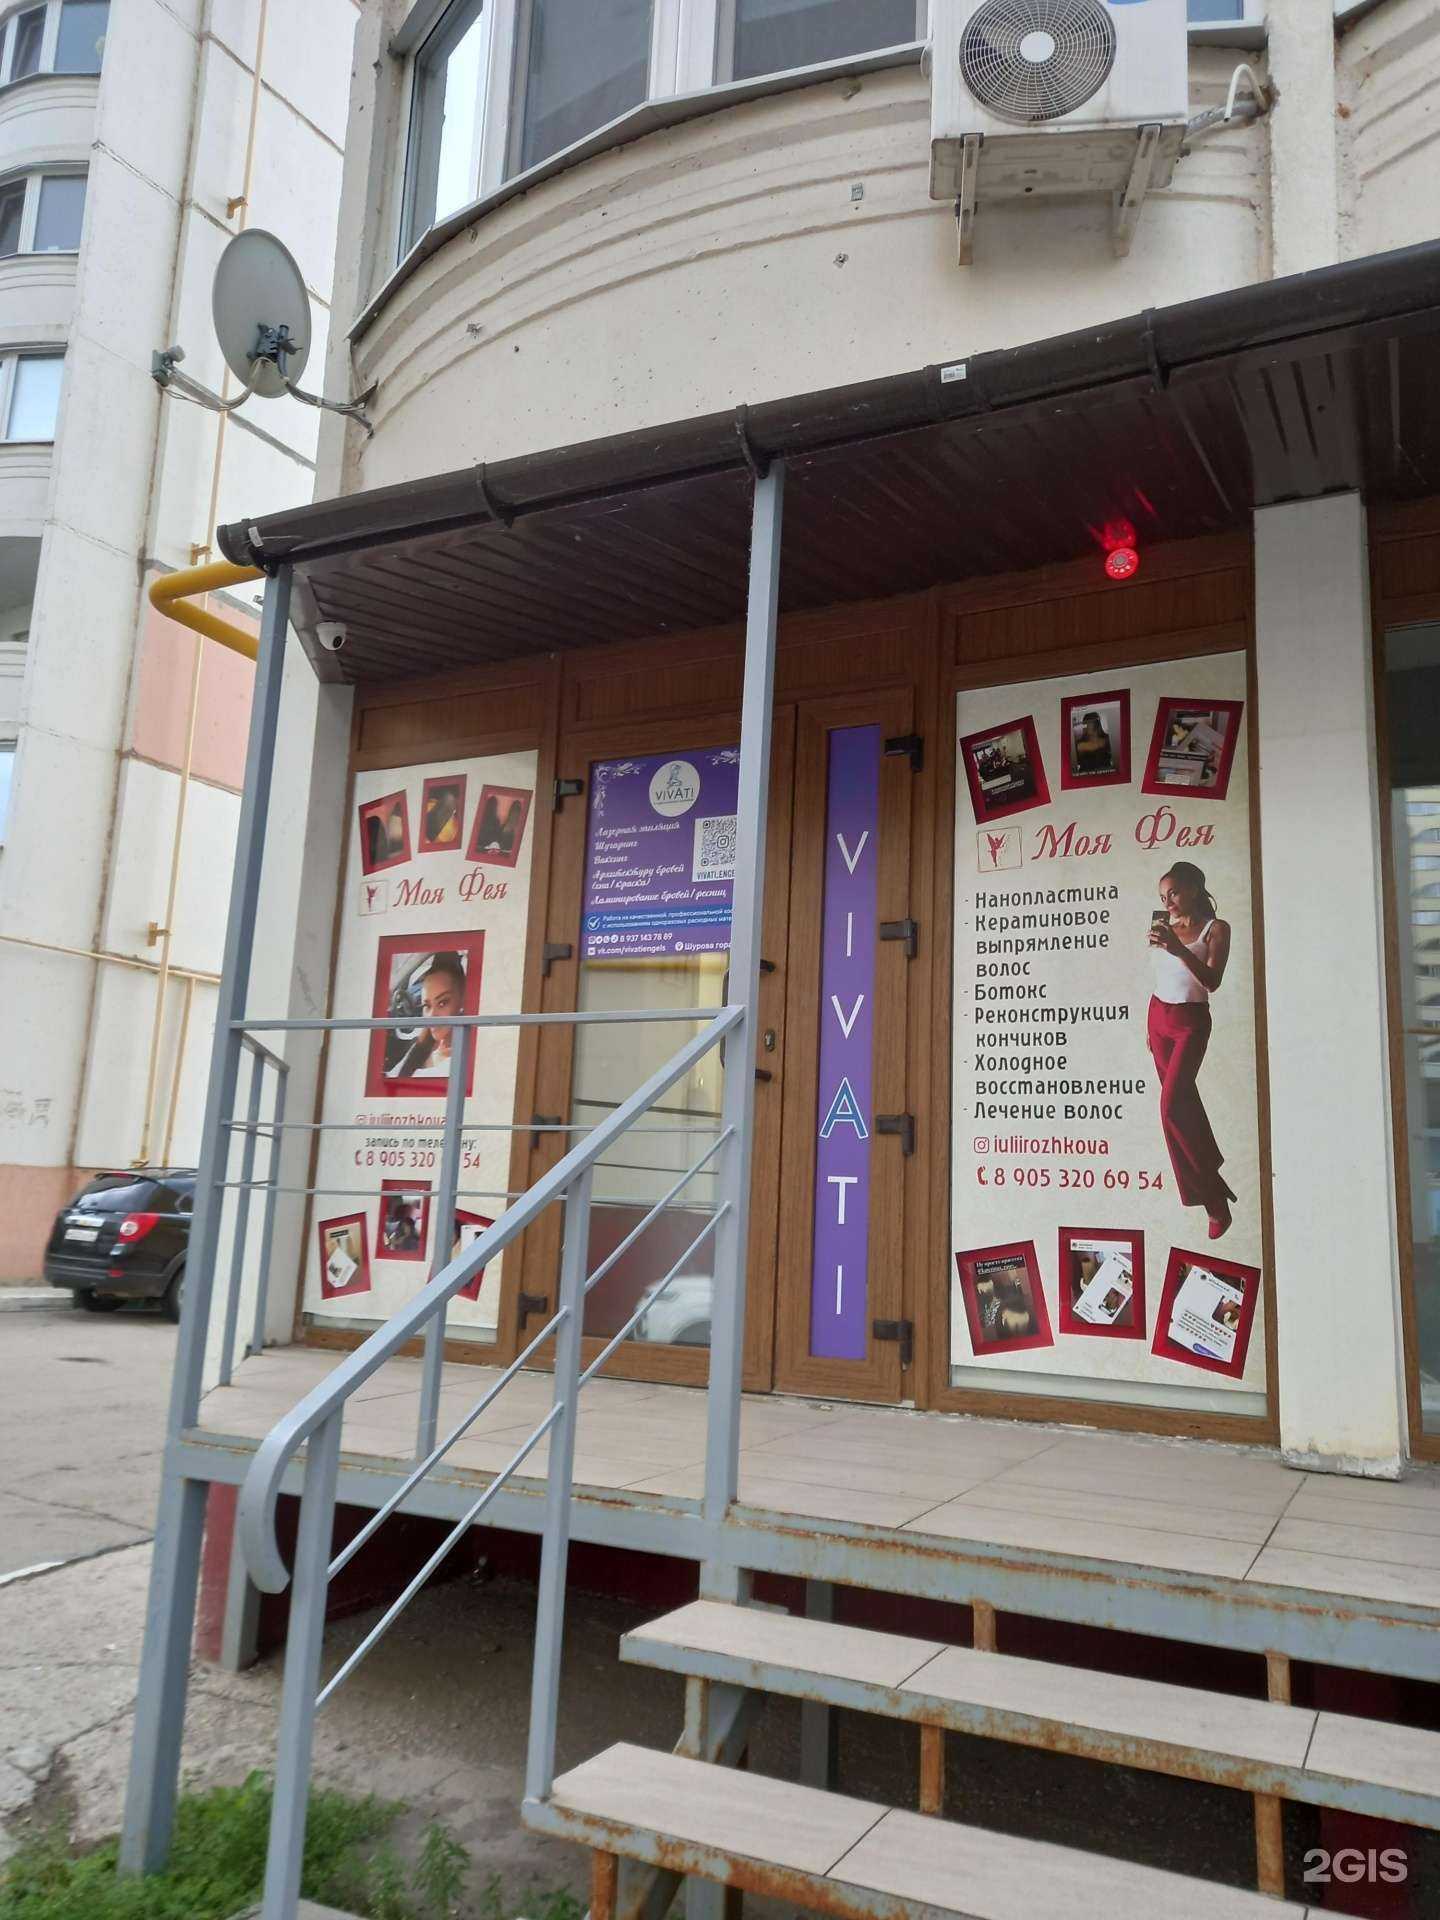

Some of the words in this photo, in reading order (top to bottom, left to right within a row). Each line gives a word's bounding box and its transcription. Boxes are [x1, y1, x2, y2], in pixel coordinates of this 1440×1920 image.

[1031, 822, 1112, 860] Моя
[1135, 805, 1215, 850] Фея
[392, 877, 444, 907] Моя
[459, 866, 508, 902] Фея
[975, 885, 1119, 909] Нанопластика
[975, 909, 1110, 933] Кератиновое
[976, 933, 1110, 956] выпрямление
[976, 961, 1031, 978] волос
[975, 983, 1048, 1001] Ботокс
[975, 1005, 1129, 1025] Реконструкция
[976, 1031, 1068, 1048] кончиков
[819, 830, 869, 1315] VIVATI
[974, 1054, 1068, 1074] Холодное
[975, 1079, 1146, 1095] восстановление
[974, 1101, 1056, 1119] Лечение
[1064, 1103, 1123, 1119] волос
[365, 1138, 400, 1148] запись
[402, 1139, 415, 1148] по
[994, 1135, 1110, 1155] iuliirozhkova
[366, 1150, 375, 1166] 8
[380, 1150, 405, 1167] 905
[410, 1151, 435, 1168] 320
[463, 1152, 480, 1169] 54
[994, 1168, 1006, 1186] 8
[1013, 1168, 1051, 1187] 905
[1059, 1169, 1095, 1188] 320
[1103, 1169, 1130, 1189] 69
[1138, 1171, 1164, 1190] 54
